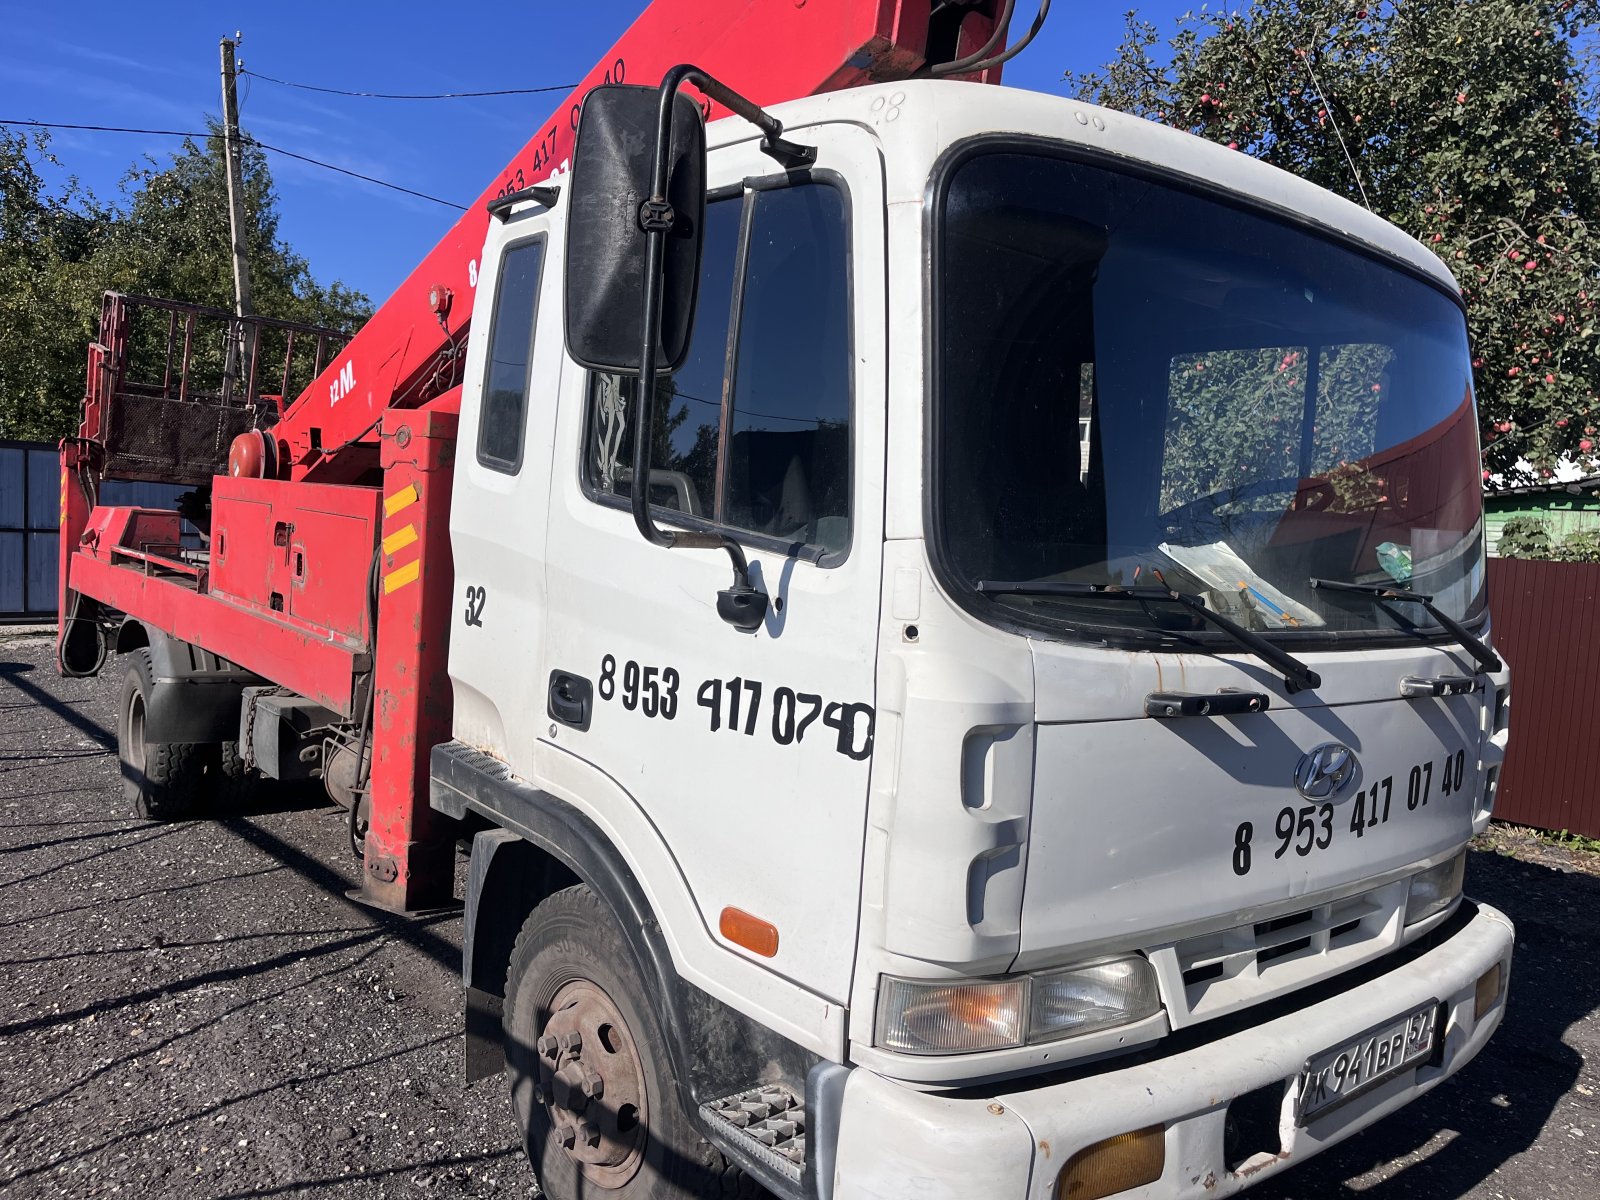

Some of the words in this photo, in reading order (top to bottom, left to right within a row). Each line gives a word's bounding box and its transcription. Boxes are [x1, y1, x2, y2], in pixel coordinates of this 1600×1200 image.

[533, 125, 557, 172] 417
[465, 586, 487, 628] 32
[599, 654, 616, 701] 8
[622, 660, 680, 721] 953
[697, 676, 762, 736] 417
[1232, 821, 1254, 877] 8
[1274, 802, 1334, 860] 953
[1349, 776, 1393, 839] 417
[1406, 760, 1433, 812] 07
[1441, 749, 1466, 798] 40
[1408, 1013, 1428, 1045] 57
